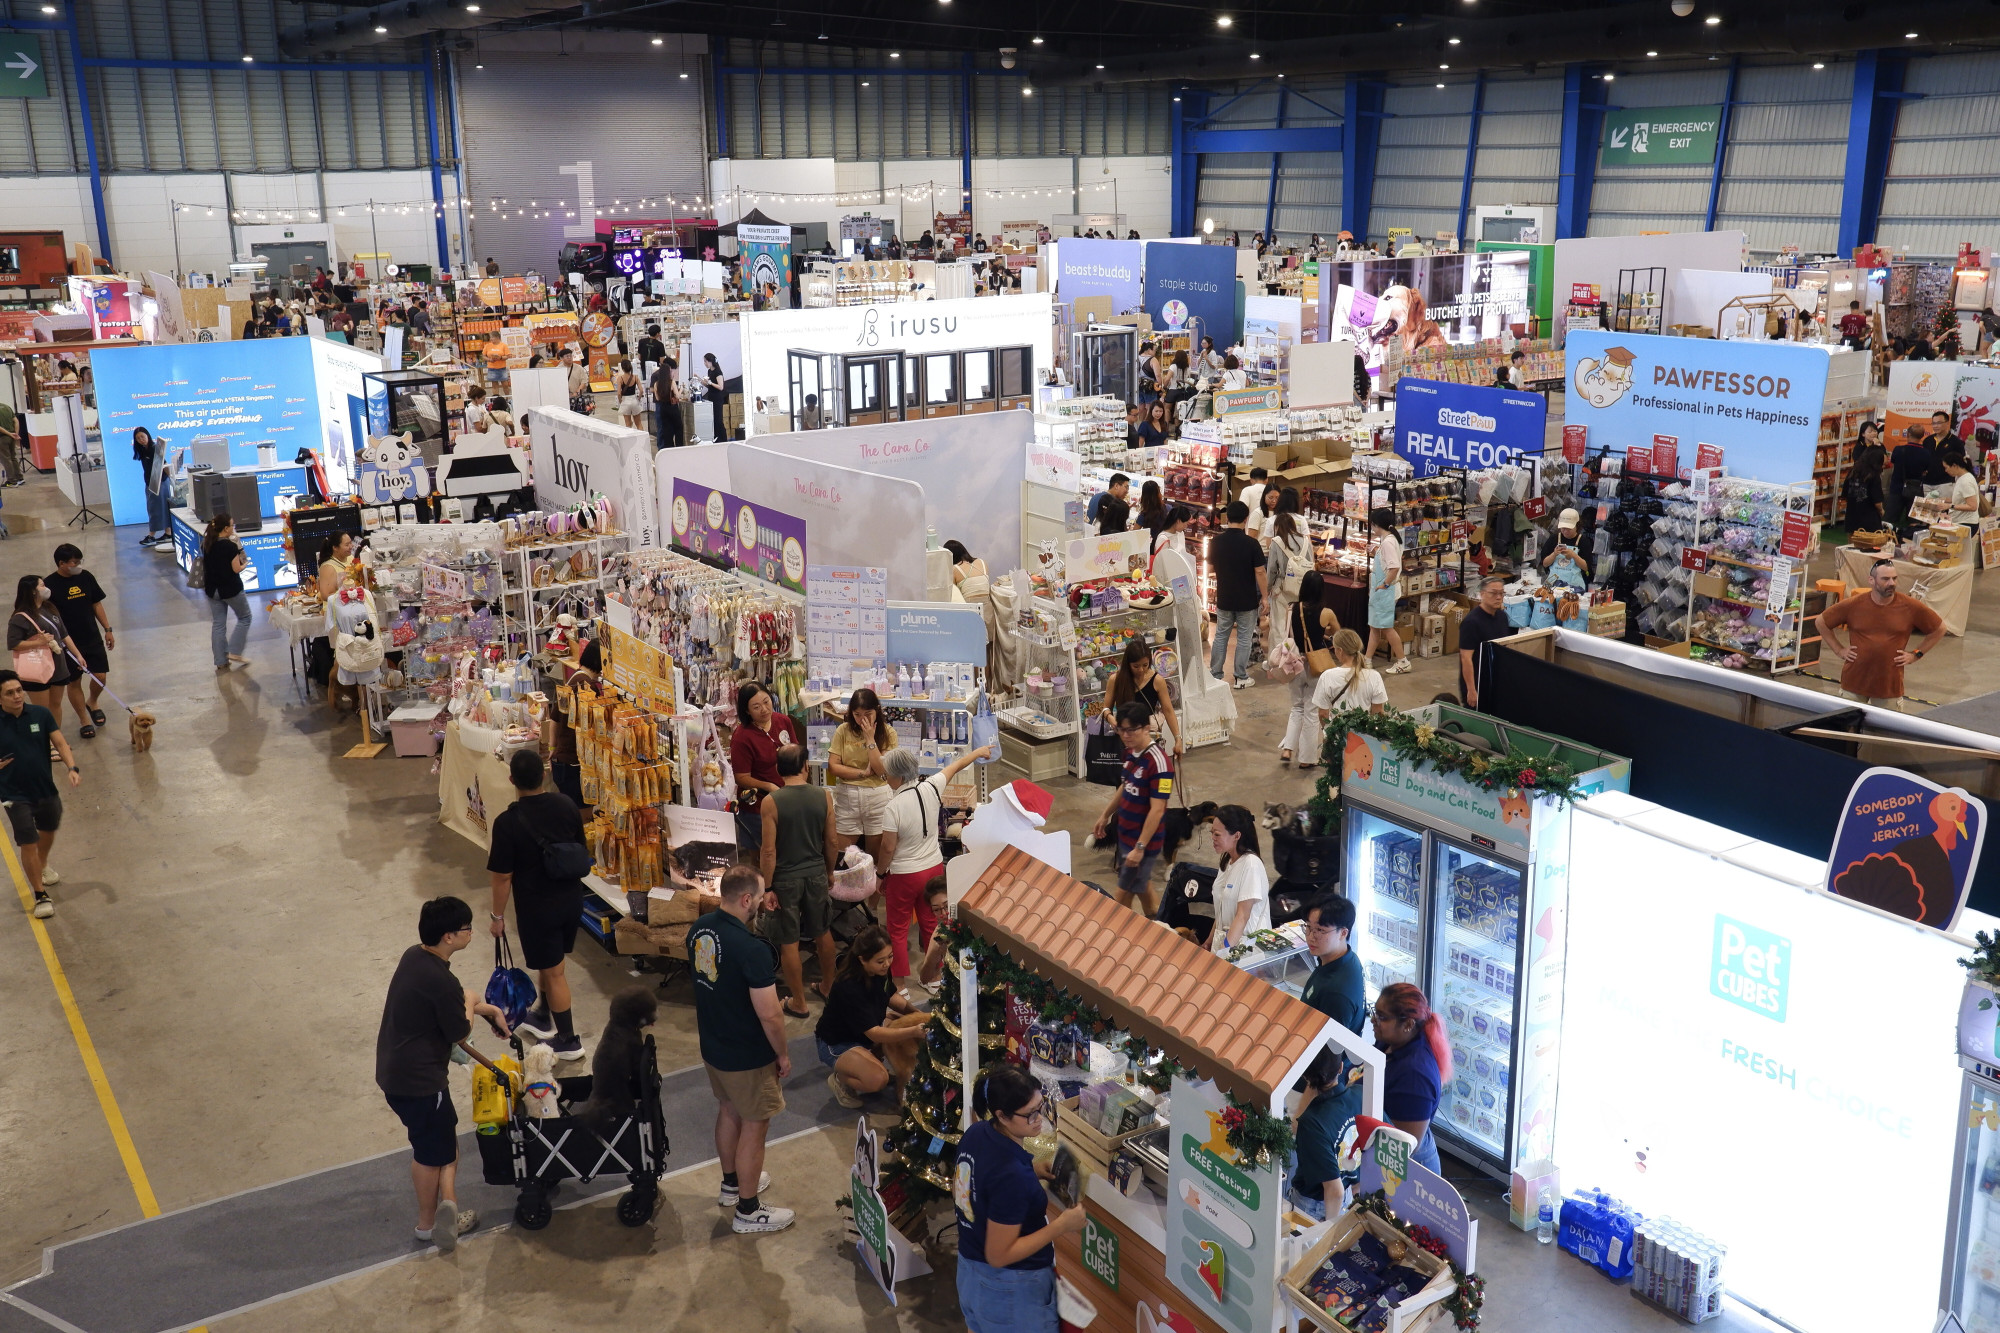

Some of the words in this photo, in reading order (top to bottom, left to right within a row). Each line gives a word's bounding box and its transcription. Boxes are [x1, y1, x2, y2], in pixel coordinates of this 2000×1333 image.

[1651, 121, 1715, 134] EMERGENCY
[1669, 137, 1691, 149] EXIT
[558, 161, 595, 238] 1
[1065, 262, 1092, 276] beast
[1098, 264, 1131, 282] buddy
[1159, 277, 1186, 292] staple
[1188, 282, 1218, 293] studio
[1455, 294, 1472, 304] YOUR
[1474, 293, 1490, 303] PETS
[1425, 305, 1464, 320] BUTCHER
[1466, 304, 1483, 317] CUT
[1485, 302, 1519, 316] PROTEIN
[891, 314, 957, 338] irusu
[1653, 365, 1791, 399] PAWFESSOR
[175, 399, 210, 407] collaboration
[1228, 395, 1265, 406] PAWFURRY
[1633, 394, 1701, 414] Professional
[1703, 402, 1714, 415] in
[1717, 404, 1743, 419] Pets
[1745, 408, 1810, 427] Happiness
[158, 419, 203, 430] CHANGES
[207, 415, 263, 426] EVERYTHING.
[175, 409, 194, 418] This
[197, 409, 209, 417] air
[210, 406, 244, 418] purifier
[1440, 411, 1494, 430] StreetPaw
[860, 443, 880, 459] The
[882, 441, 911, 457] Cara
[914, 438, 930, 453] Co
[1407, 431, 1460, 461] REAL
[1466, 440, 1526, 468] FOOD
[551, 433, 594, 501] hoy.
[1424, 459, 1438, 477] for
[381, 473, 411, 490] hoy.
[793, 477, 808, 495] The
[809, 481, 829, 500] Cara
[641, 525, 653, 547] hoy.
[900, 612, 938, 627] plume
[1382, 760, 1399, 777] Pet
[1381, 773, 1399, 787] CUBES
[1406, 767, 1433, 786] Fresh
[1436, 775, 1472, 799] Frozen
[1405, 777, 1425, 798] Dog
[1426, 785, 1446, 802] and
[1448, 792, 1469, 809] Cat
[1471, 801, 1496, 821] Food
[1855, 792, 1925, 816] SOMEBODY
[1876, 811, 1906, 827] SAID
[1871, 824, 1921, 844] JERKY?!
[1543, 864, 1567, 881] Dog
[1721, 922, 1782, 986] Pet
[1717, 967, 1780, 1015] CUBES
[1018, 1015, 1035, 1026] FEA
[1720, 1038, 1797, 1091] FRESH
[1378, 1131, 1405, 1163] Pet
[1377, 1149, 1404, 1176] CUBES
[1190, 1146, 1213, 1173] FREE
[1214, 1165, 1251, 1201] Tasting!
[1413, 1179, 1459, 1221] Treats
[861, 1203, 876, 1230] FREE
[1205, 1204, 1219, 1218] PORK
[857, 1211, 881, 1253] BUFFET?
[1085, 1220, 1115, 1266] Pet
[1085, 1248, 1116, 1286] CUBES
